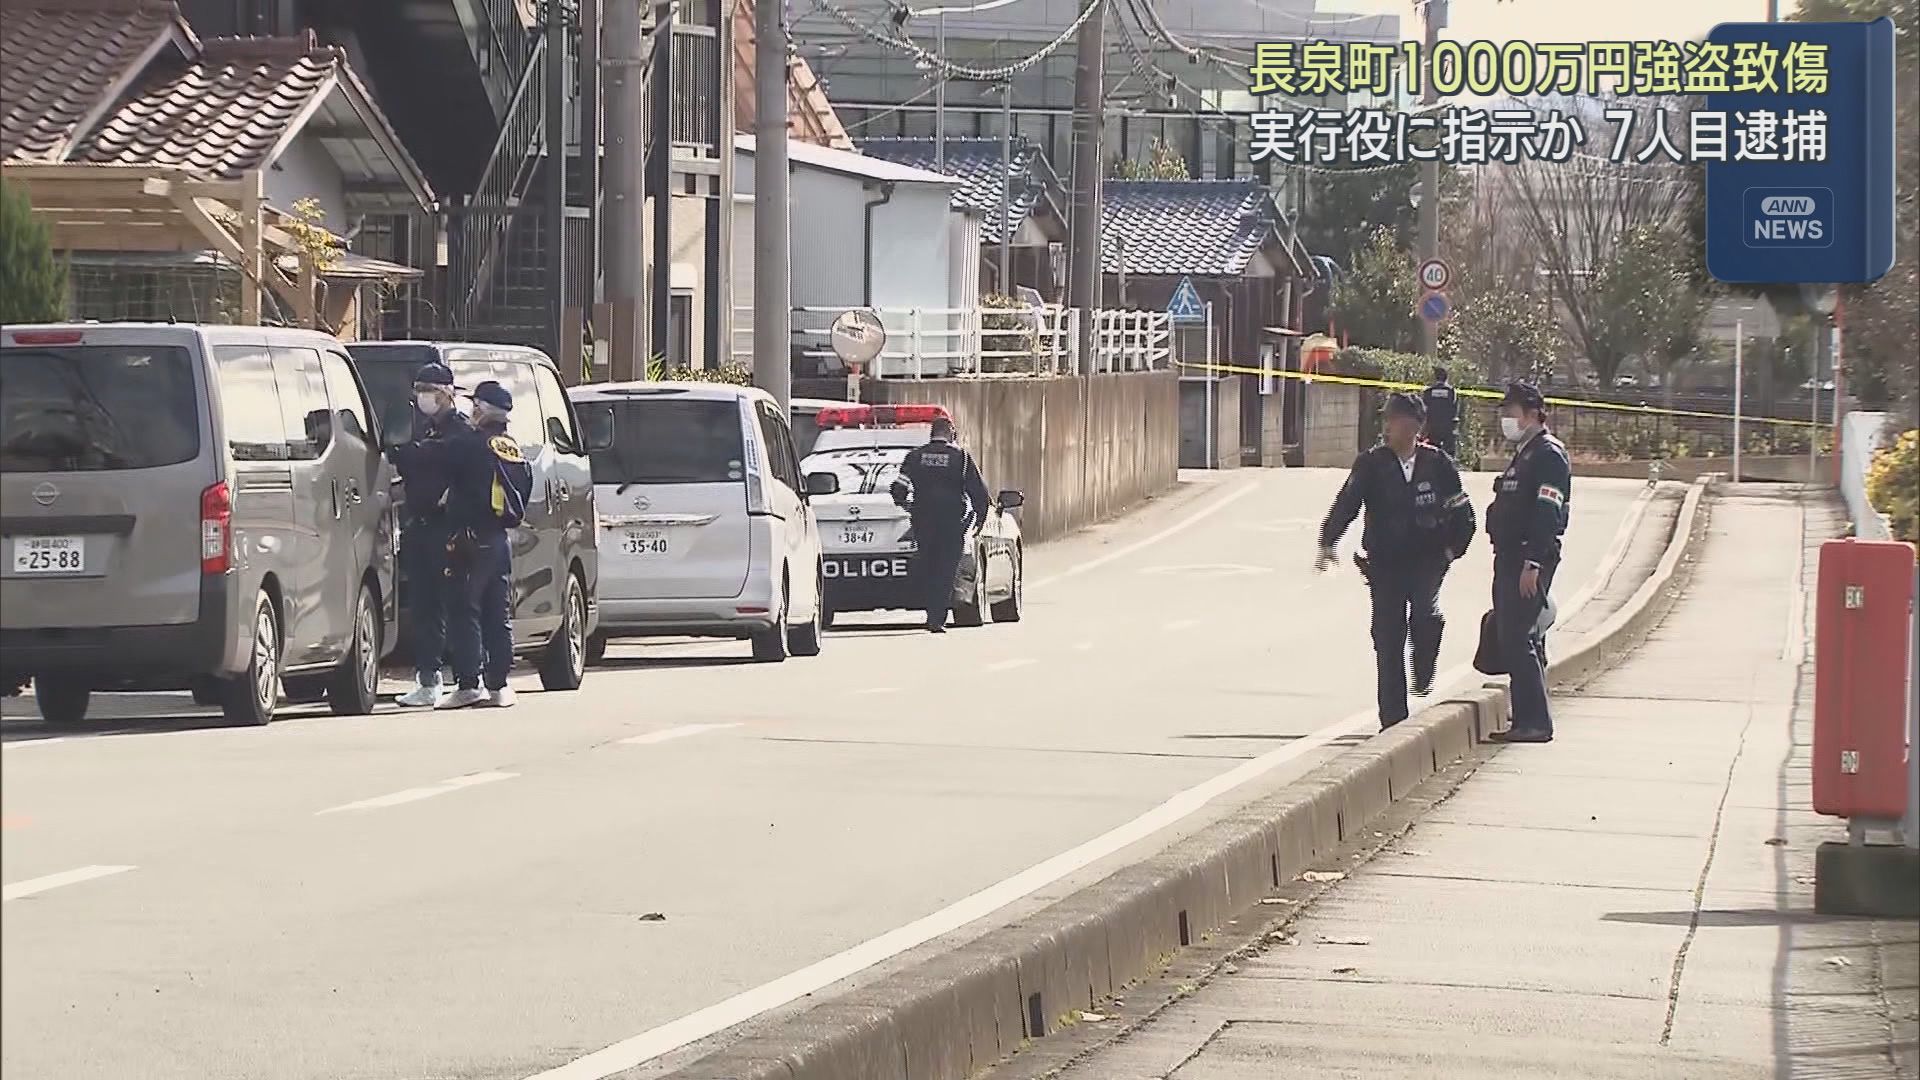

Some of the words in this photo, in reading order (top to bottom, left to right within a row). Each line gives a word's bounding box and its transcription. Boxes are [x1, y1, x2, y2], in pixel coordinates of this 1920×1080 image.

[1426, 268, 1444, 282] 40
[843, 531, 874, 544] 38-47
[629, 539, 667, 554] 35-40
[30, 551, 80, 569] 25-88
[822, 559, 908, 578] OLICE
